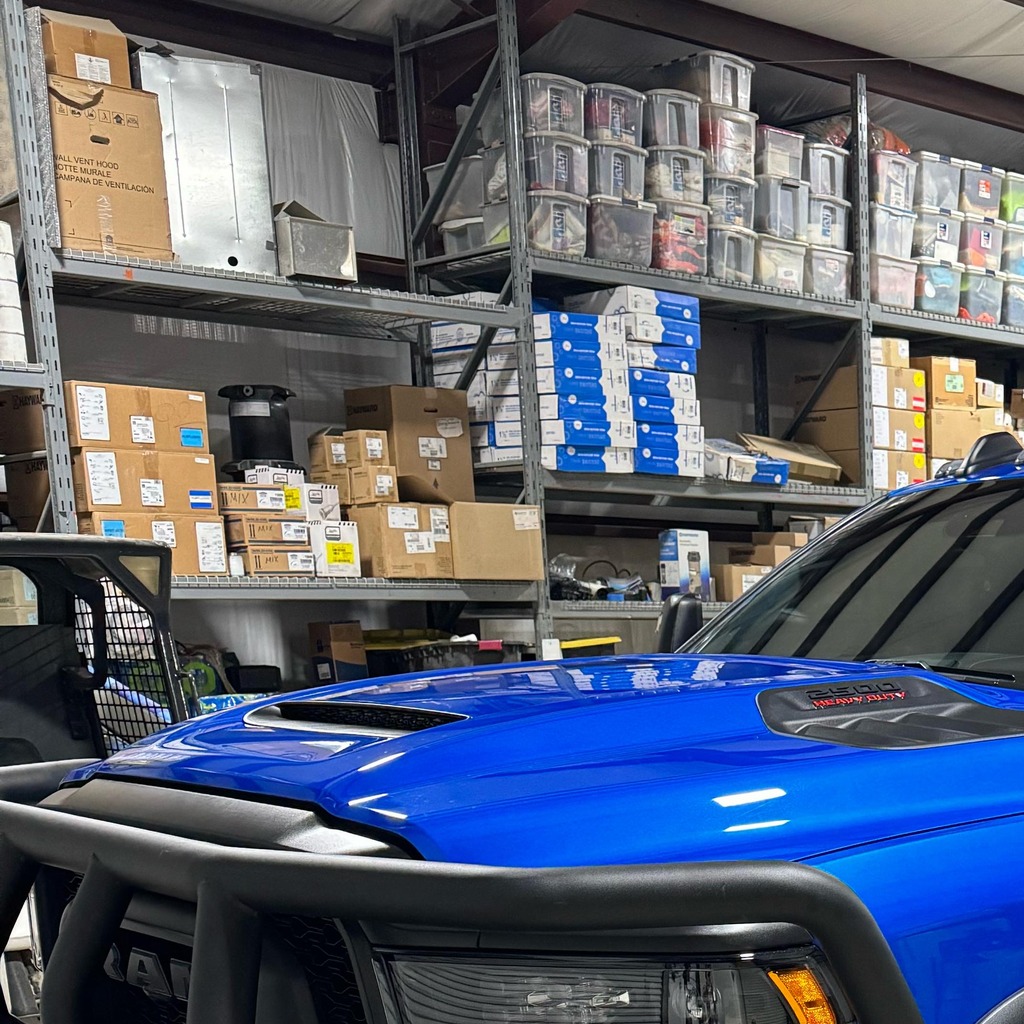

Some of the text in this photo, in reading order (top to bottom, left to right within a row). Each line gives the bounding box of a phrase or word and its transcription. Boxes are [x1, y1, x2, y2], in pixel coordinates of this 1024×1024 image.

[73, 156, 94, 166] VENT
[96, 160, 119, 170] HOOD
[80, 167, 112, 178] MURALE
[93, 178, 104, 187] DE
[105, 181, 155, 194] VENTILACIÓN
[20, 395, 41, 407] HAYWA
[806, 682, 902, 700] 2500
[812, 691, 906, 710] HEAVY DUTY
